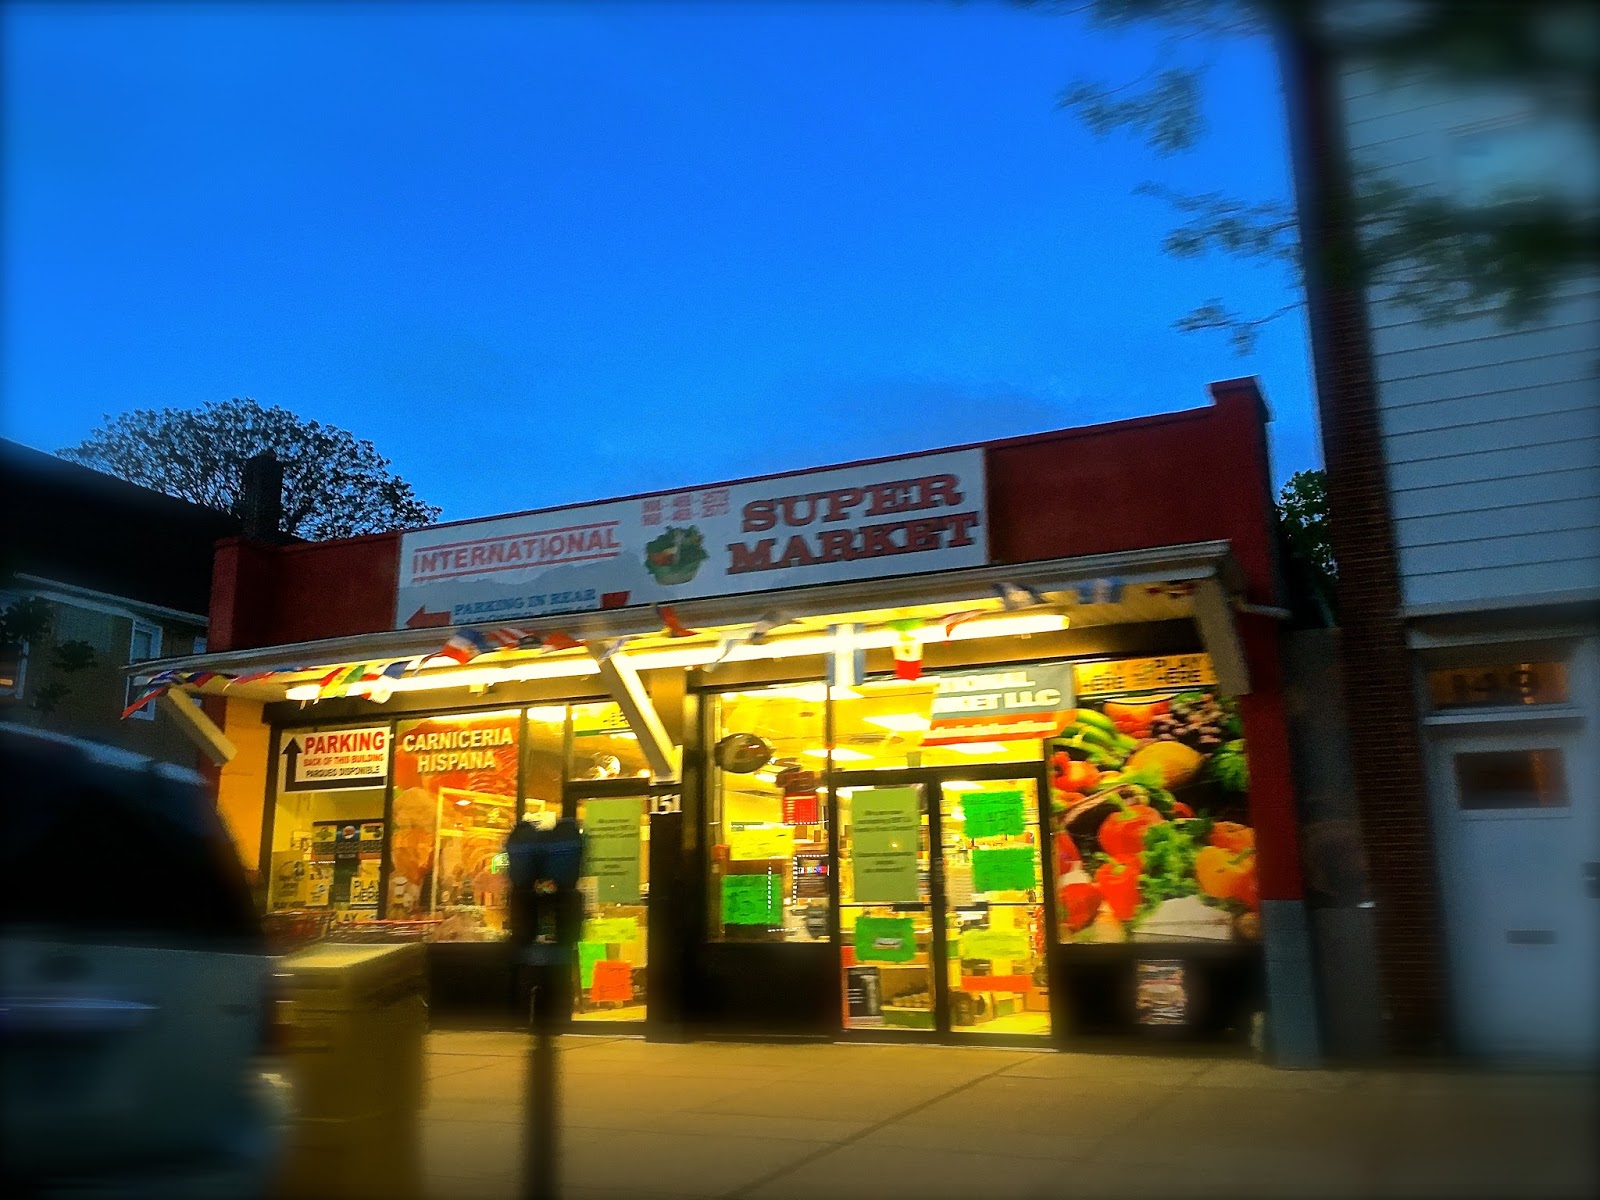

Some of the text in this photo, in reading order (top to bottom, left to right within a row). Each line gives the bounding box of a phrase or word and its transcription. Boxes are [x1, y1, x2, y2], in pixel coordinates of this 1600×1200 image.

[741, 473, 966, 534] SUPER
[412, 528, 621, 574] INTERNATIONAL
[725, 511, 980, 575] MARKET
[454, 597, 525, 615] PARKING
[527, 595, 547, 607] IN
[304, 731, 385, 755] PARKING
[402, 727, 514, 752] CARNICERIA
[351, 753, 384, 763] BUILDING
[417, 749, 497, 773] HISPANA
[649, 794, 682, 814] 151
